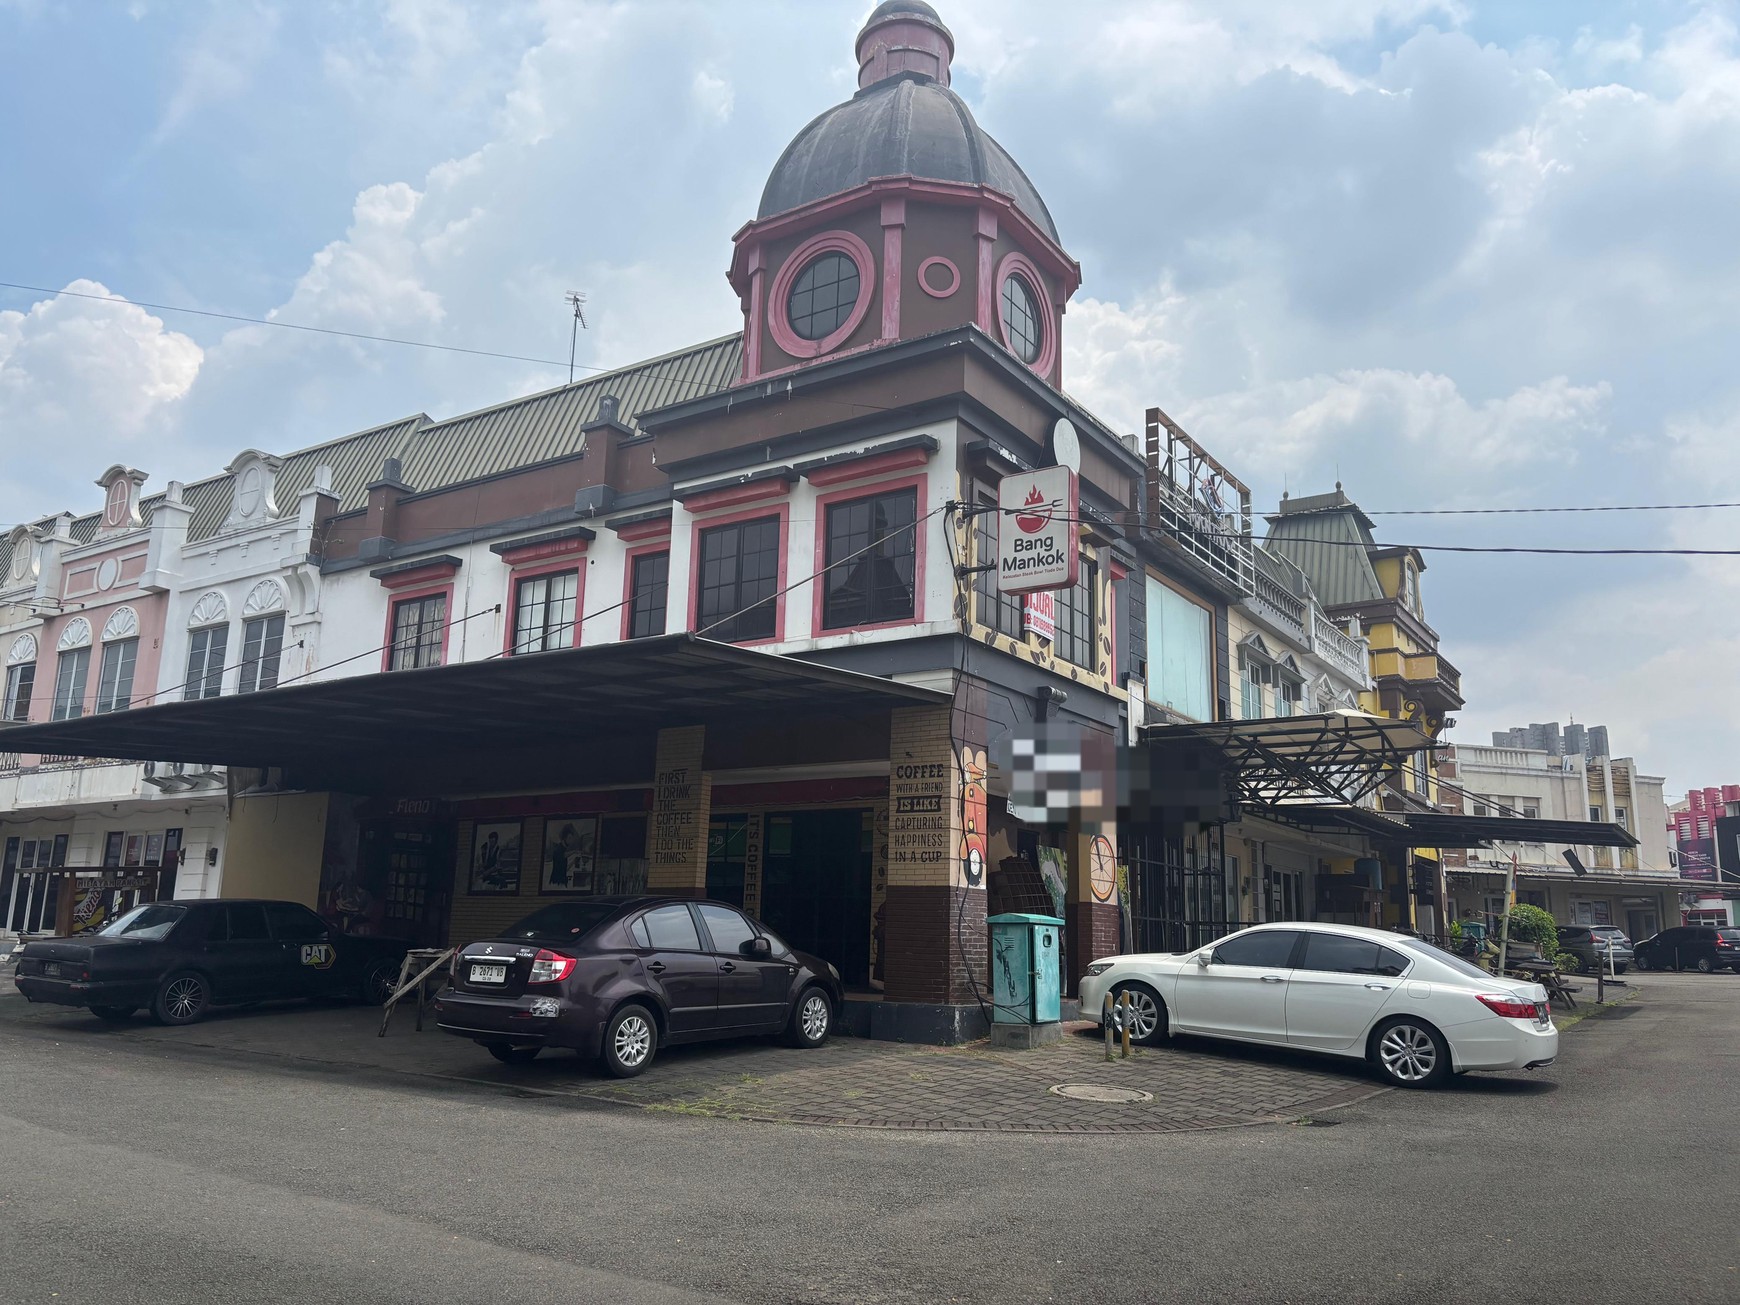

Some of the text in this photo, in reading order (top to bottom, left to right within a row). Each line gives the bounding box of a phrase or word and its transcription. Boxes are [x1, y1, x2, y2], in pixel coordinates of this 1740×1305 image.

[1014, 536, 1054, 552] Bang
[1002, 549, 1064, 572] Mankok
[896, 764, 944, 778] COFFEE
[658, 772, 687, 784] FIRST
[663, 784, 690, 799] DRINK
[896, 782, 942, 793] WITH A FRIEND
[658, 800, 676, 812] THE
[900, 798, 938, 810] IS LIKE
[656, 812, 692, 825] COFFEE
[895, 816, 942, 830] CAPTURING
[656, 826, 680, 837] THEN
[661, 838, 673, 850] DO
[677, 838, 694, 850] THE
[895, 834, 942, 847] HAPPINESS
[655, 852, 686, 863] THINGS
[895, 850, 942, 862] IN A CUP
[746, 844, 758, 901] COFFEE
[302, 946, 327, 963] CAT
[472, 965, 476, 975] B
